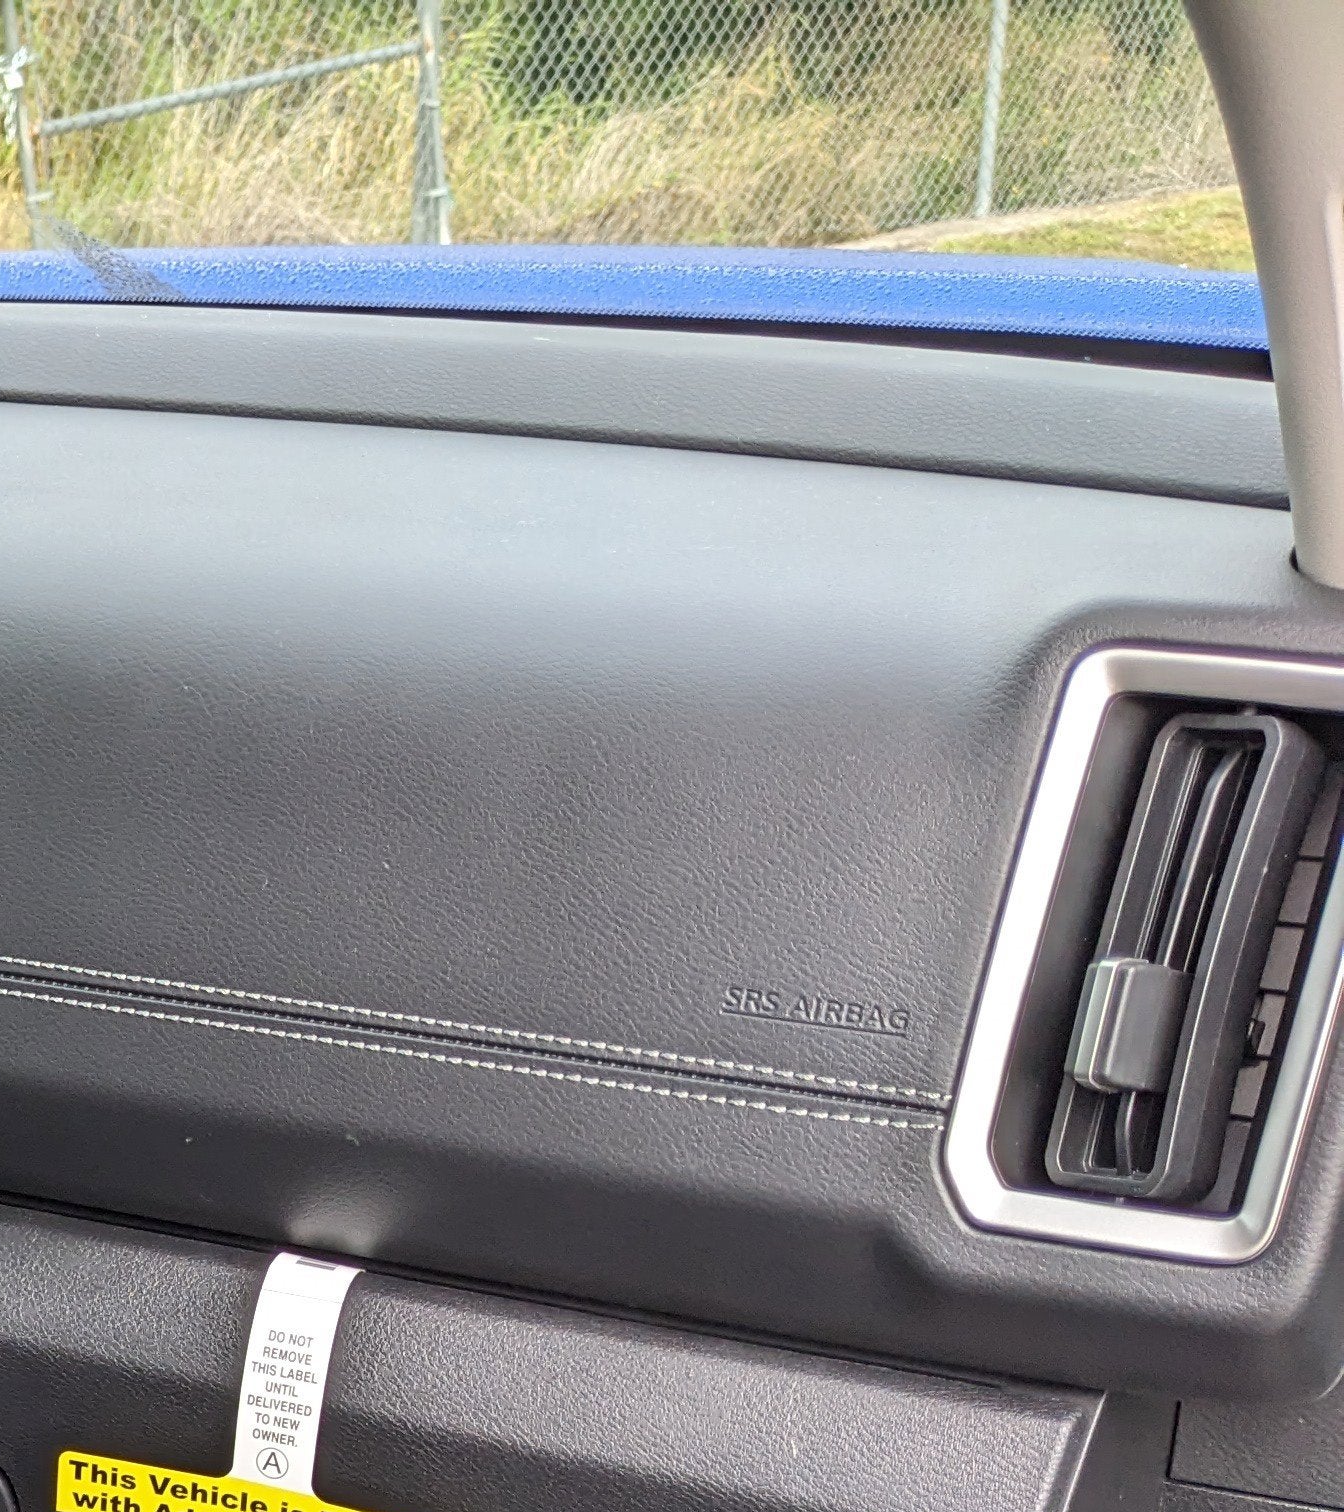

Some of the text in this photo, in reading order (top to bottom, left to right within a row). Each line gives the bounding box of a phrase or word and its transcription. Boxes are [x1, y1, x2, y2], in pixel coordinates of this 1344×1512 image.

[722, 986, 910, 1032] SRS AIRBAG
[268, 1329, 314, 1349] DO NOT
[262, 1346, 313, 1366] REMOVE
[251, 1361, 318, 1384] THIS LABEL
[265, 1380, 299, 1397] UNTIL
[247, 1394, 312, 1417] DELIVERED
[255, 1412, 301, 1431] TO NEW
[252, 1428, 298, 1447] OWNER.
[262, 1451, 282, 1475] A
[69, 1460, 137, 1490] This
